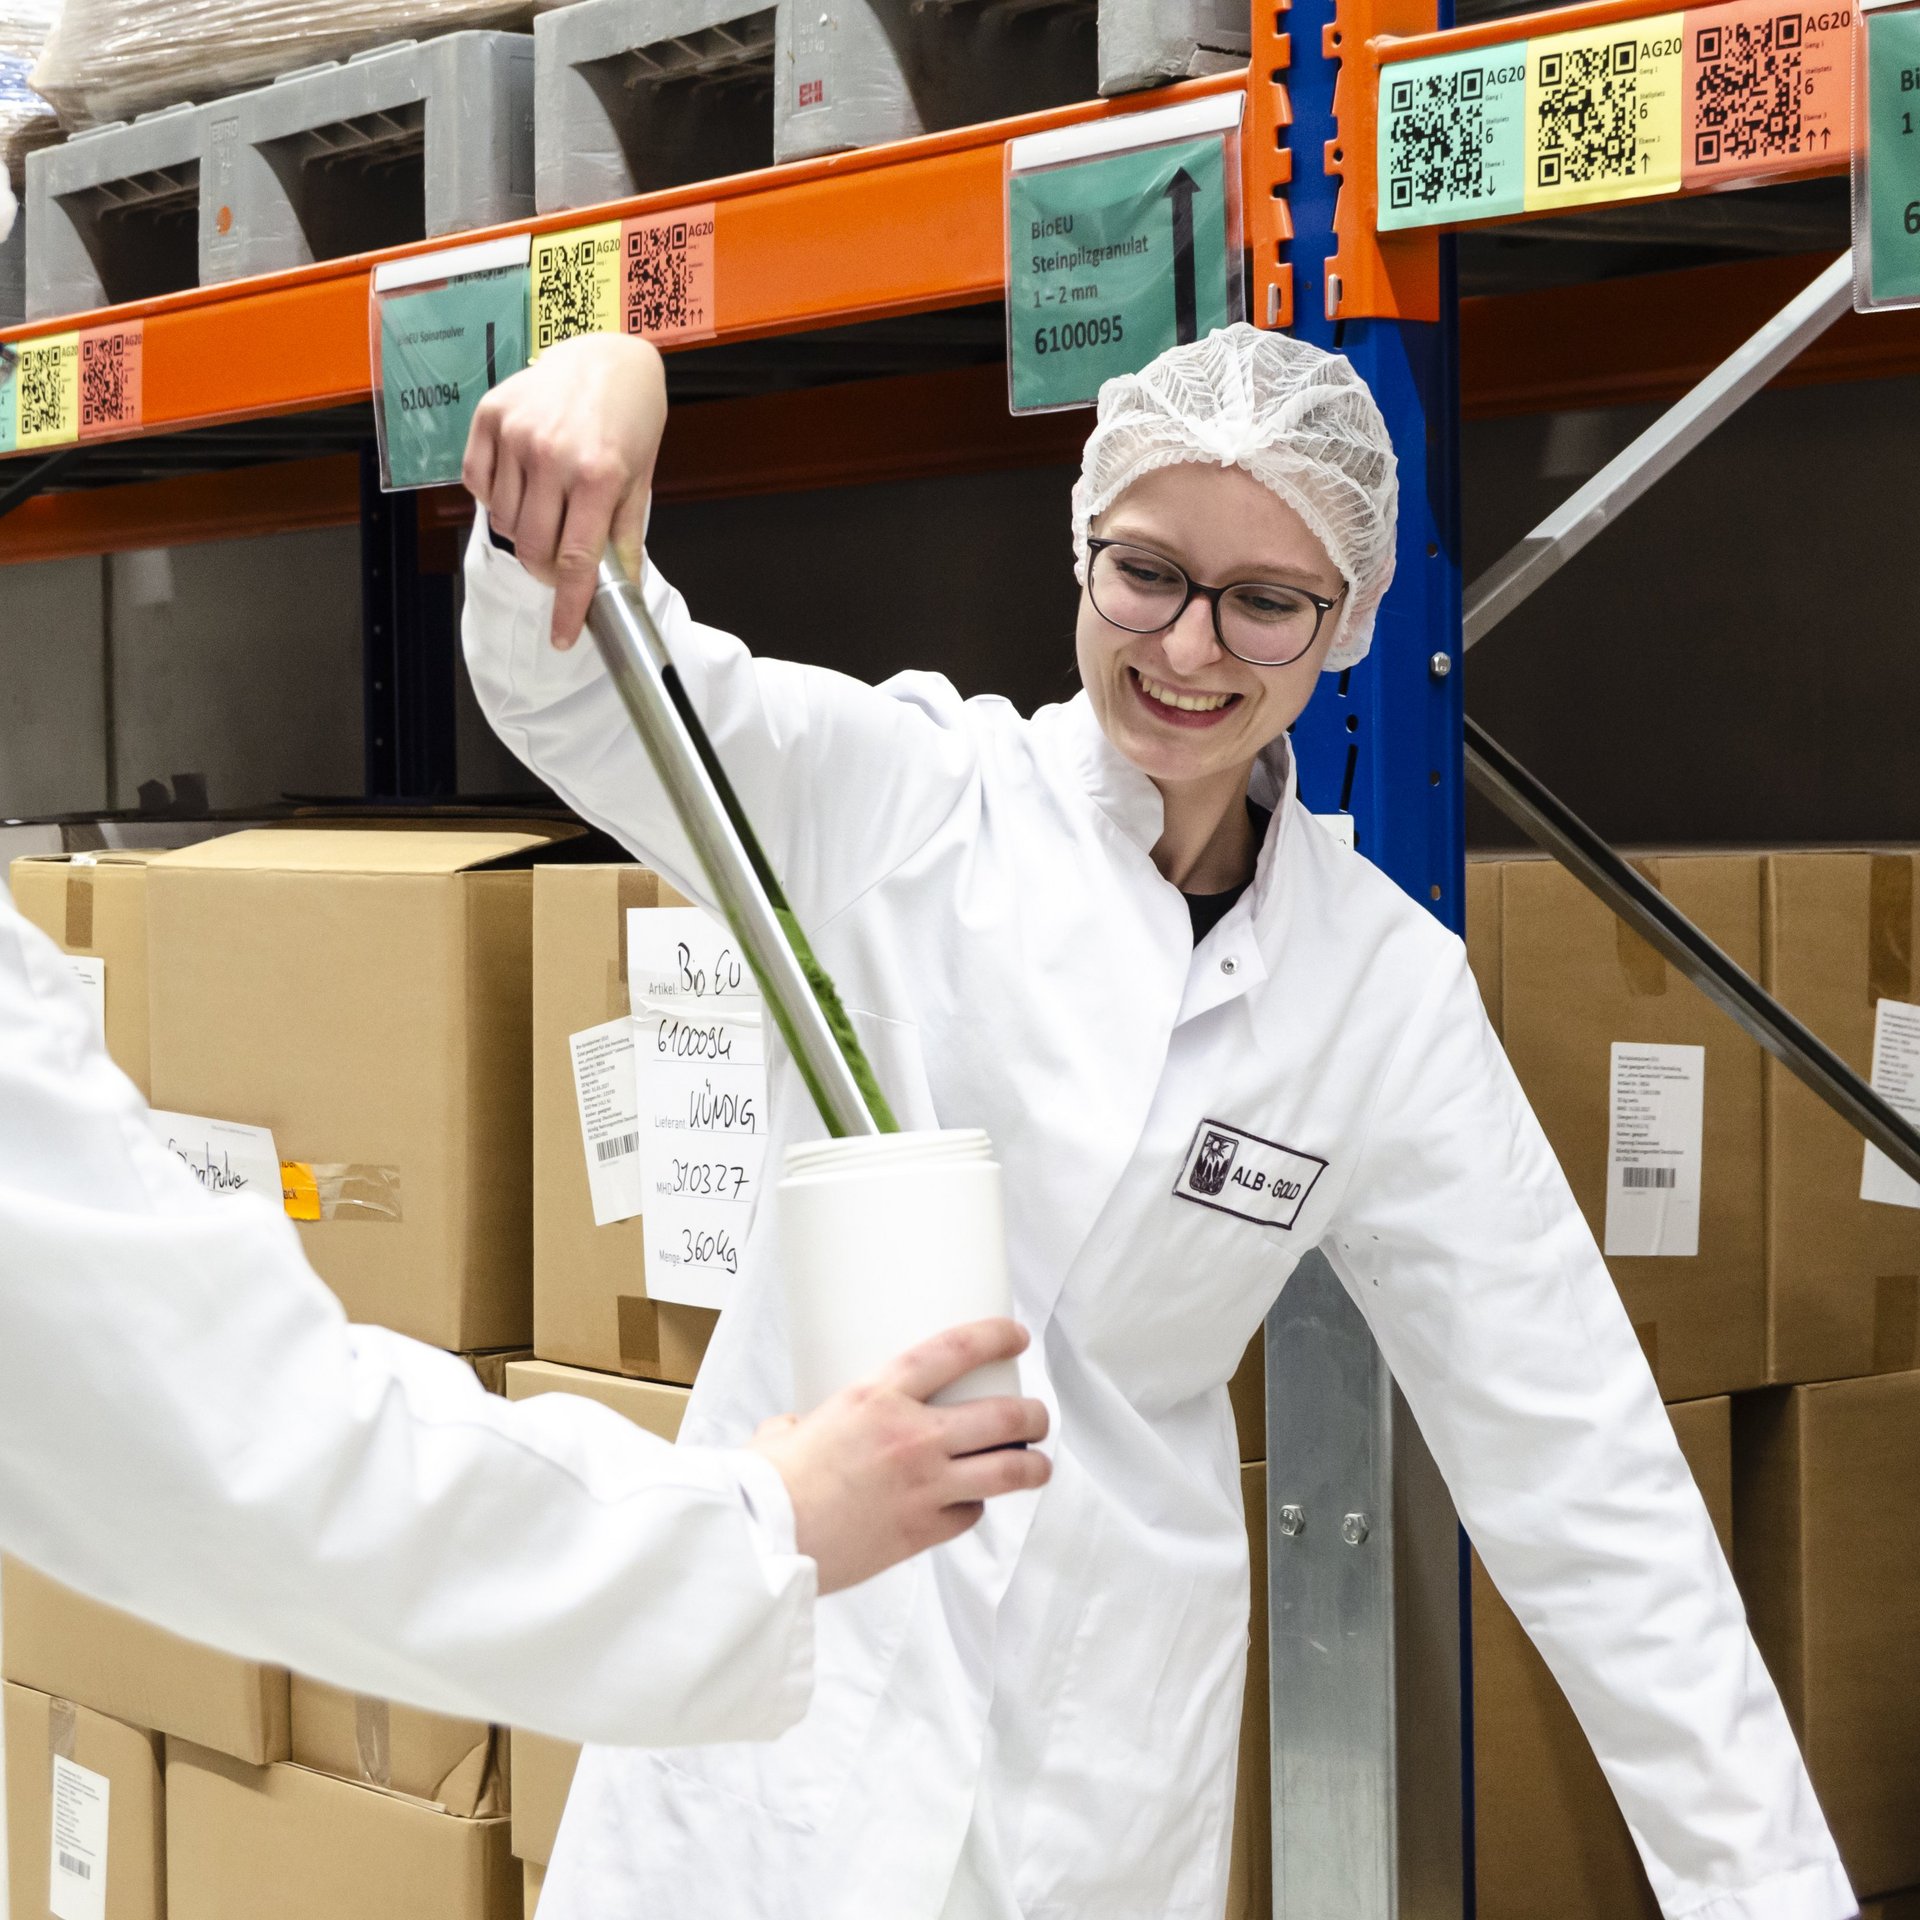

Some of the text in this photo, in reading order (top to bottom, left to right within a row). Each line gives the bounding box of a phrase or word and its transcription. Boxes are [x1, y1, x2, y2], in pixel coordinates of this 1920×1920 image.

[1804, 10, 1851, 34] AG20
[1639, 38, 1682, 60] AG20
[1485, 65, 1526, 87] AG20
[1804, 77, 1814, 95] 6
[1639, 102, 1648, 119] 6
[1485, 127, 1494, 144] 6
[688, 221, 714, 238] AG20
[1031, 215, 1073, 240] BioEU
[596, 239, 620, 255] AG20
[1032, 235, 1149, 273] Steinpilzgranulat
[688, 271, 694, 284] 5
[596, 286, 602, 299] 5
[1033, 290, 1041, 308] 1
[1058, 286, 1067, 304] 2
[1071, 284, 1098, 300] mm
[1035, 315, 1123, 355] 6100095
[400, 382, 460, 411] 6100094
[648, 942, 741, 997] Artikel: Bio EU
[658, 1019, 732, 1060] 6100094
